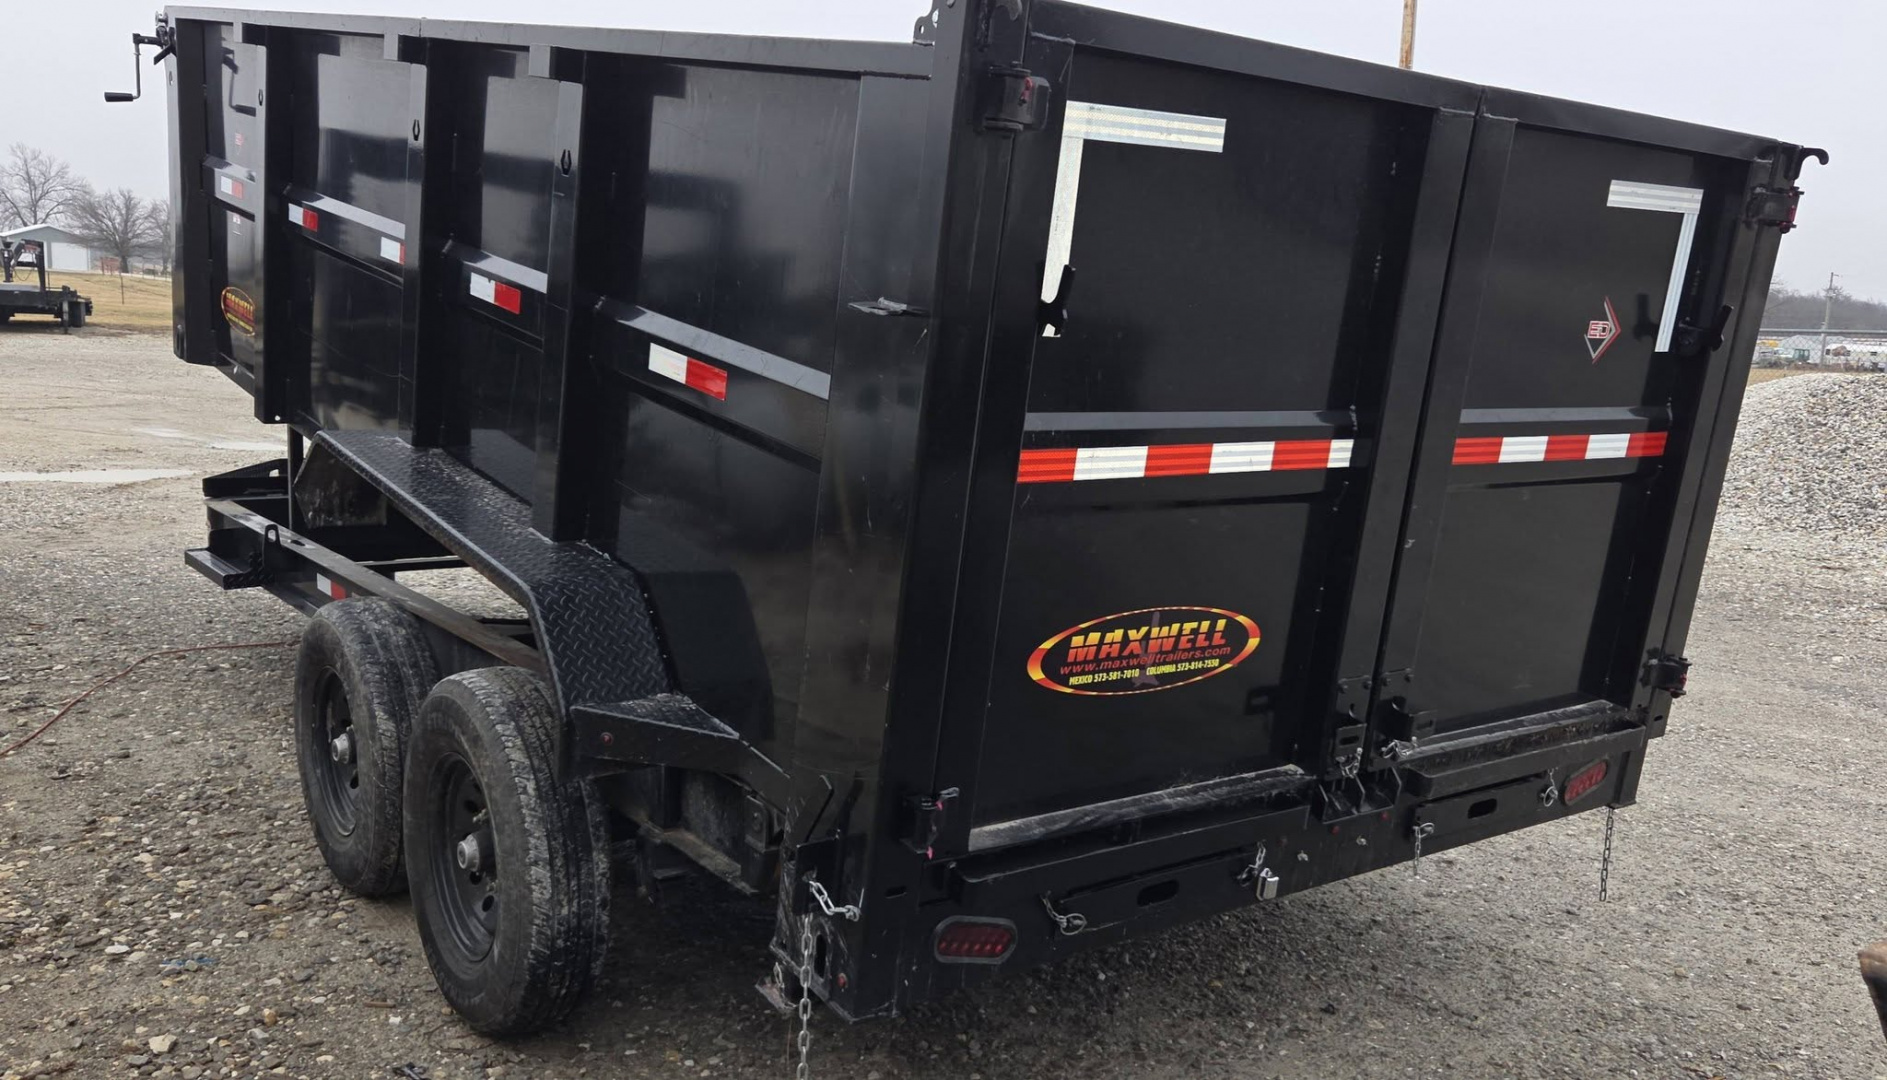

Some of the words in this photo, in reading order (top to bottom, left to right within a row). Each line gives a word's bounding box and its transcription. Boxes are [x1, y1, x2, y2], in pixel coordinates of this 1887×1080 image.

[1067, 619, 1228, 663] MAXWELL
[1060, 646, 1232, 675] www.maxwelltrailers.com
[1069, 674, 1093, 686] MEXICO
[1093, 668, 1140, 683] 573-581-7010
[1146, 664, 1177, 676] COLUMBIA
